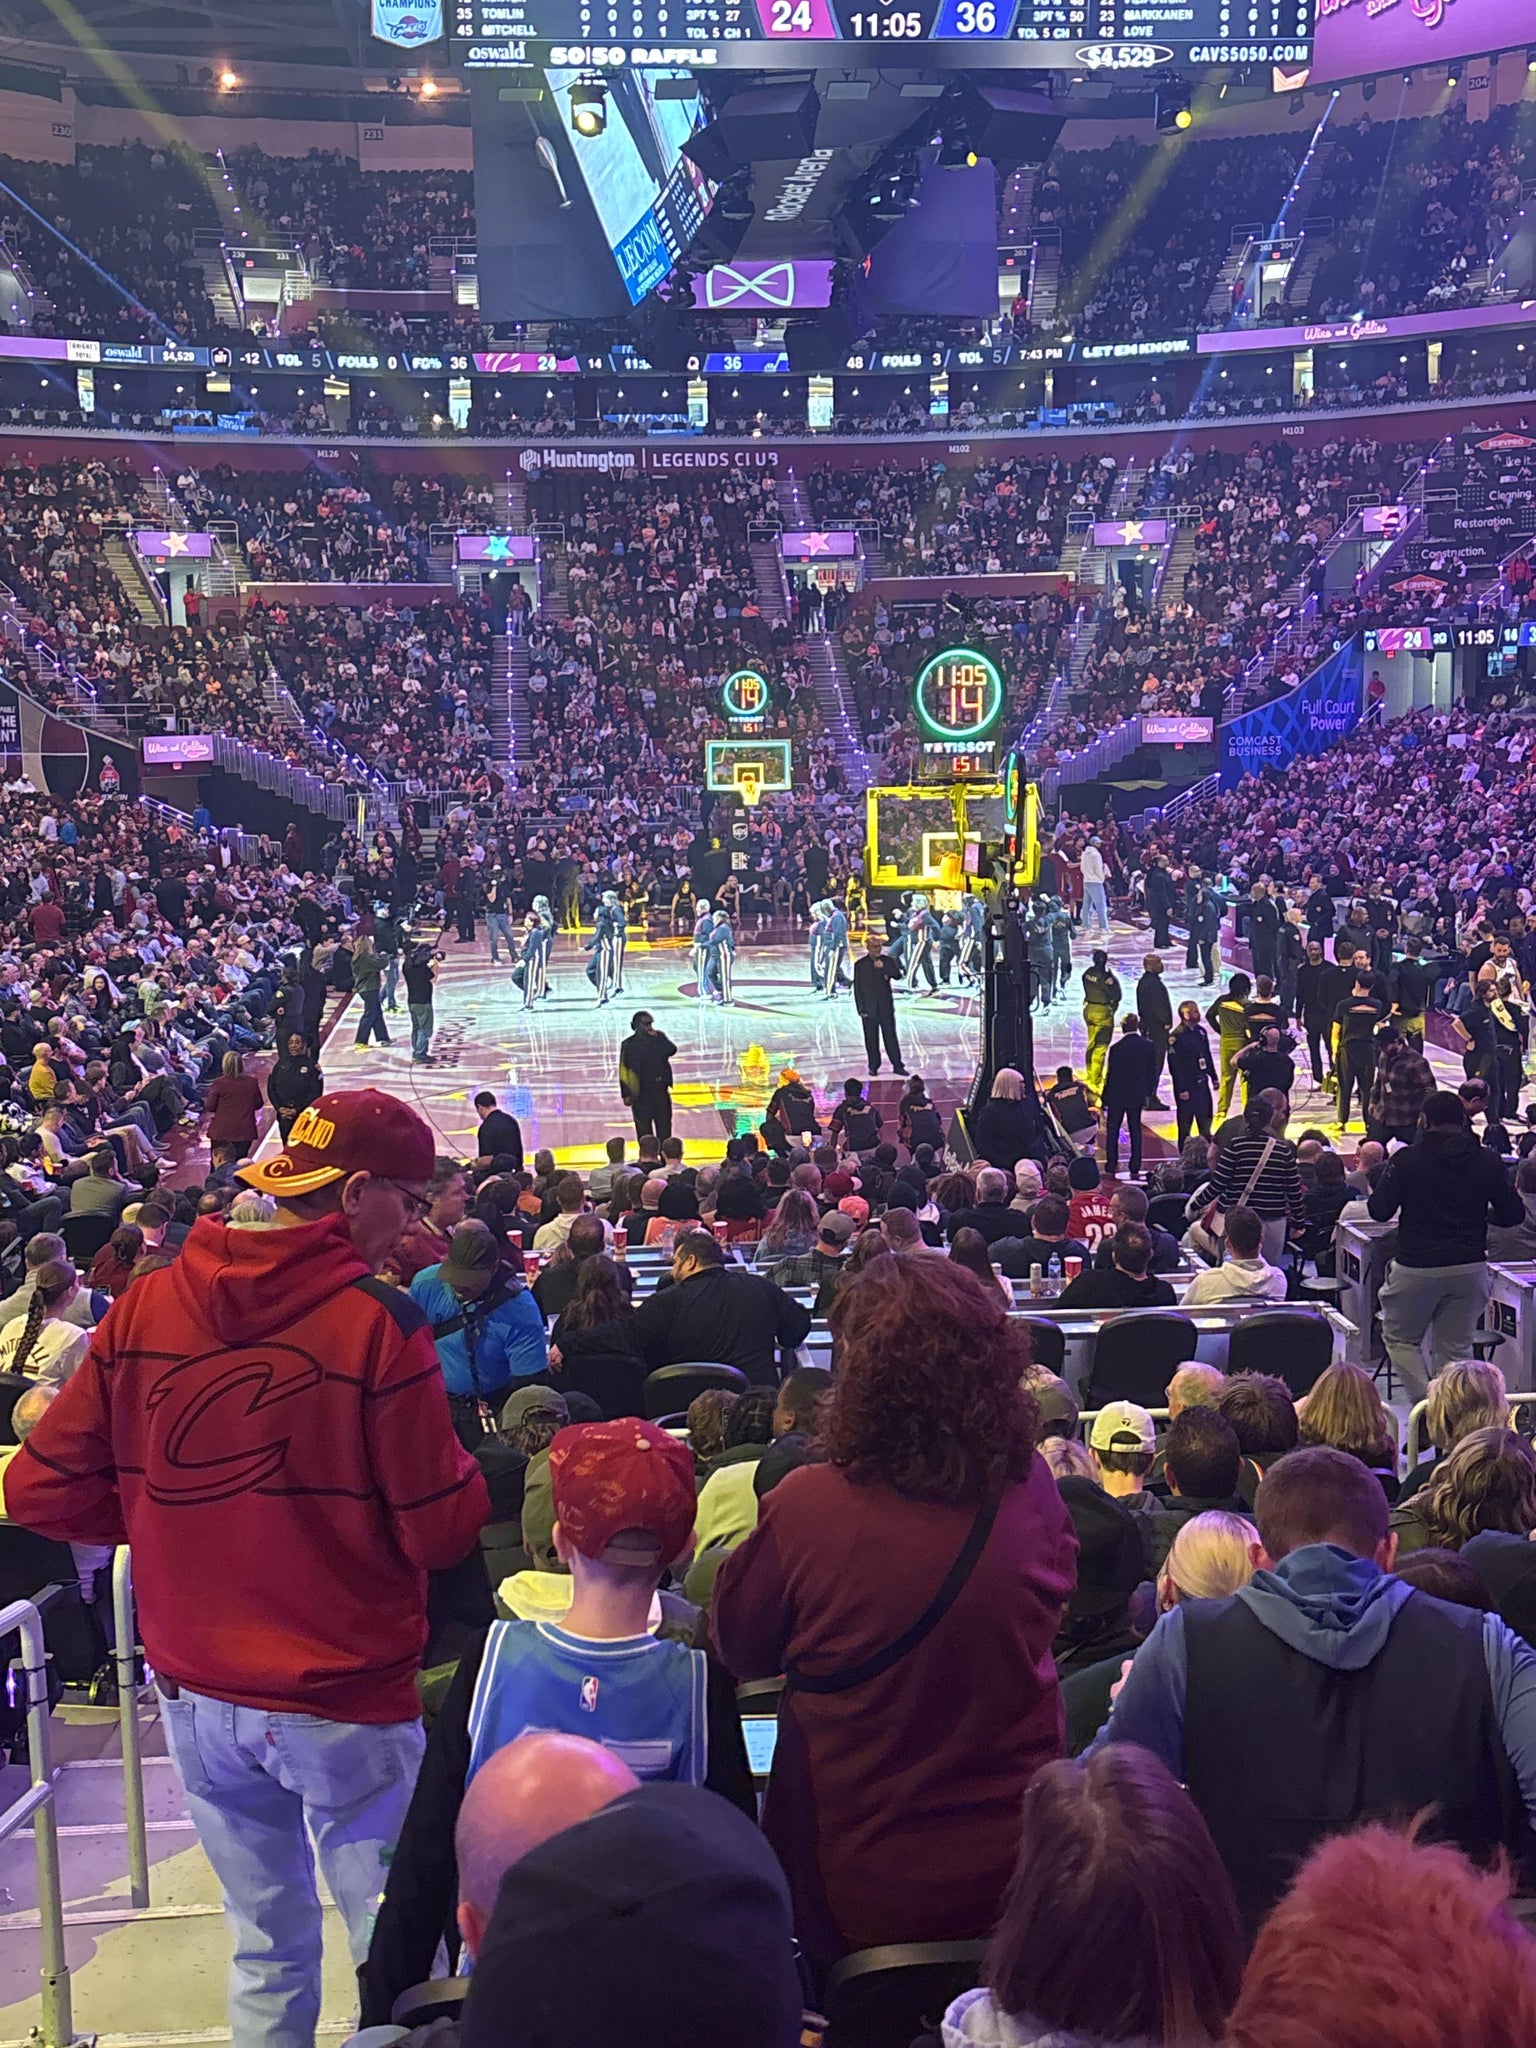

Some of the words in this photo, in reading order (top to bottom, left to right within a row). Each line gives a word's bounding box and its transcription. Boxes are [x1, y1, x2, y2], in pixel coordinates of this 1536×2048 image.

[456, 8, 473, 19] 35
[481, 8, 524, 19] TOMLIN
[580, 9, 591, 21] 0
[607, 9, 618, 21] 0
[632, 9, 643, 21] 0
[658, 9, 669, 21] 0
[725, 10, 740, 21] 27
[771, 1, 812, 32] 24
[958, 2, 996, 33] 36
[1070, 11, 1084, 22] 50
[1100, 10, 1115, 21] 23
[1123, 9, 1193, 20] MARKKANEN
[1220, 9, 1230, 21] 6
[1248, 9, 1258, 20] 6
[1272, 8, 1279, 20] 1
[1297, 8, 1307, 20] 0
[457, 25, 473, 36] 45
[481, 25, 537, 36] MITCHELL
[581, 25, 591, 37] 7
[609, 26, 617, 37] 1
[633, 26, 643, 38] 0
[659, 26, 667, 37] 1
[850, 13, 922, 37] 11:05
[1099, 26, 1115, 37] 42
[1124, 26, 1153, 37] LOVE
[1220, 25, 1229, 37] 3
[1250, 25, 1256, 36] 1
[1271, 25, 1278, 36] 1
[1296, 25, 1307, 36] 0
[712, 28, 720, 38] 5
[724, 28, 741, 38] CH
[745, 28, 751, 38] 1
[1043, 28, 1050, 38] 5
[1053, 28, 1070, 39] CH
[1076, 28, 1082, 37] 1
[468, 41, 526, 60] oswald
[631, 49, 717, 64] RAFFLE
[1189, 46, 1308, 62] CAVS5050.COM
[1087, 48, 1155, 69] $4,529
[1470, 79, 1488, 88] 204
[365, 130, 383, 139] 231
[784, 149, 834, 182] Arena
[766, 183, 817, 214] Rocket
[105, 346, 143, 359] oswald
[163, 351, 195, 362] $4,529
[240, 353, 260, 365] -12
[958, 352, 984, 364] TOL
[992, 350, 1002, 363] 5
[1020, 350, 1043, 360] 7:43
[1046, 349, 1062, 359] PM
[276, 353, 303, 367] TOL
[312, 353, 322, 367] 5
[338, 355, 379, 369] FOULS
[388, 356, 398, 370] 0
[450, 356, 468, 370] 36
[538, 355, 557, 371] 24
[588, 358, 602, 369] 14
[724, 356, 743, 370] 36
[846, 356, 864, 369] 48
[882, 354, 922, 367] FOULS
[932, 353, 942, 366] 3
[1283, 426, 1304, 435] M103
[317, 450, 339, 458] M126
[949, 445, 970, 453] M102
[544, 449, 635, 472] Huntington
[653, 452, 729, 467] LEGENDS
[736, 451, 779, 466] CLUB
[1454, 516, 1515, 529] Restoration.
[1403, 631, 1422, 648] 24
[1458, 630, 1495, 645] 11:05
[1366, 639, 1375, 651] 0
[937, 665, 987, 686] 11:05
[741, 689, 759, 709] 14
[950, 687, 983, 725] 14
[1302, 700, 1321, 714] Full
[1325, 700, 1355, 714] Court
[1310, 717, 1346, 730] Power
[943, 741, 996, 753] TISSOT
[1228, 736, 1282, 746] COMCAST
[1228, 746, 1281, 756] BUSINESS
